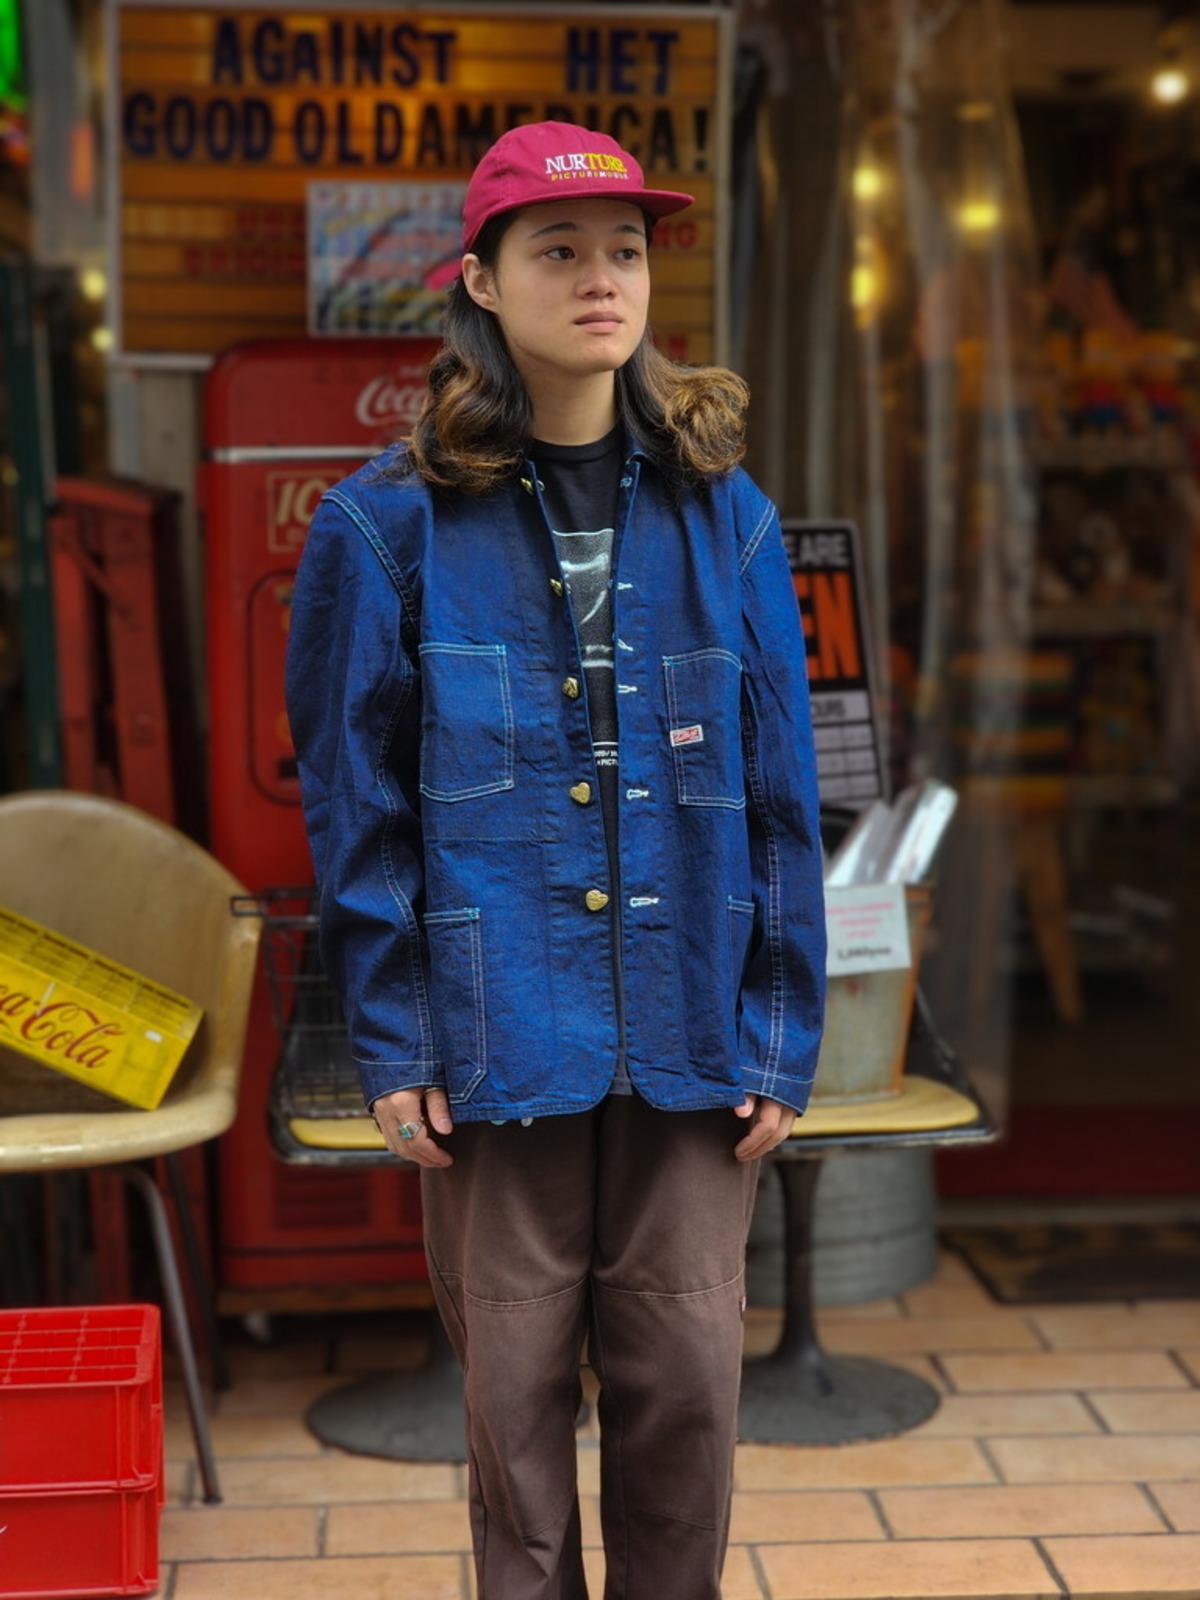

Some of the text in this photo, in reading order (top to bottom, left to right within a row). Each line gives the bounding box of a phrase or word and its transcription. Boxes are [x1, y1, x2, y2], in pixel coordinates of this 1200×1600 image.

[565, 27, 681, 96] HET
[123, 92, 275, 164] GOOD
[295, 99, 403, 166] OLD
[793, 572, 862, 680] EN
